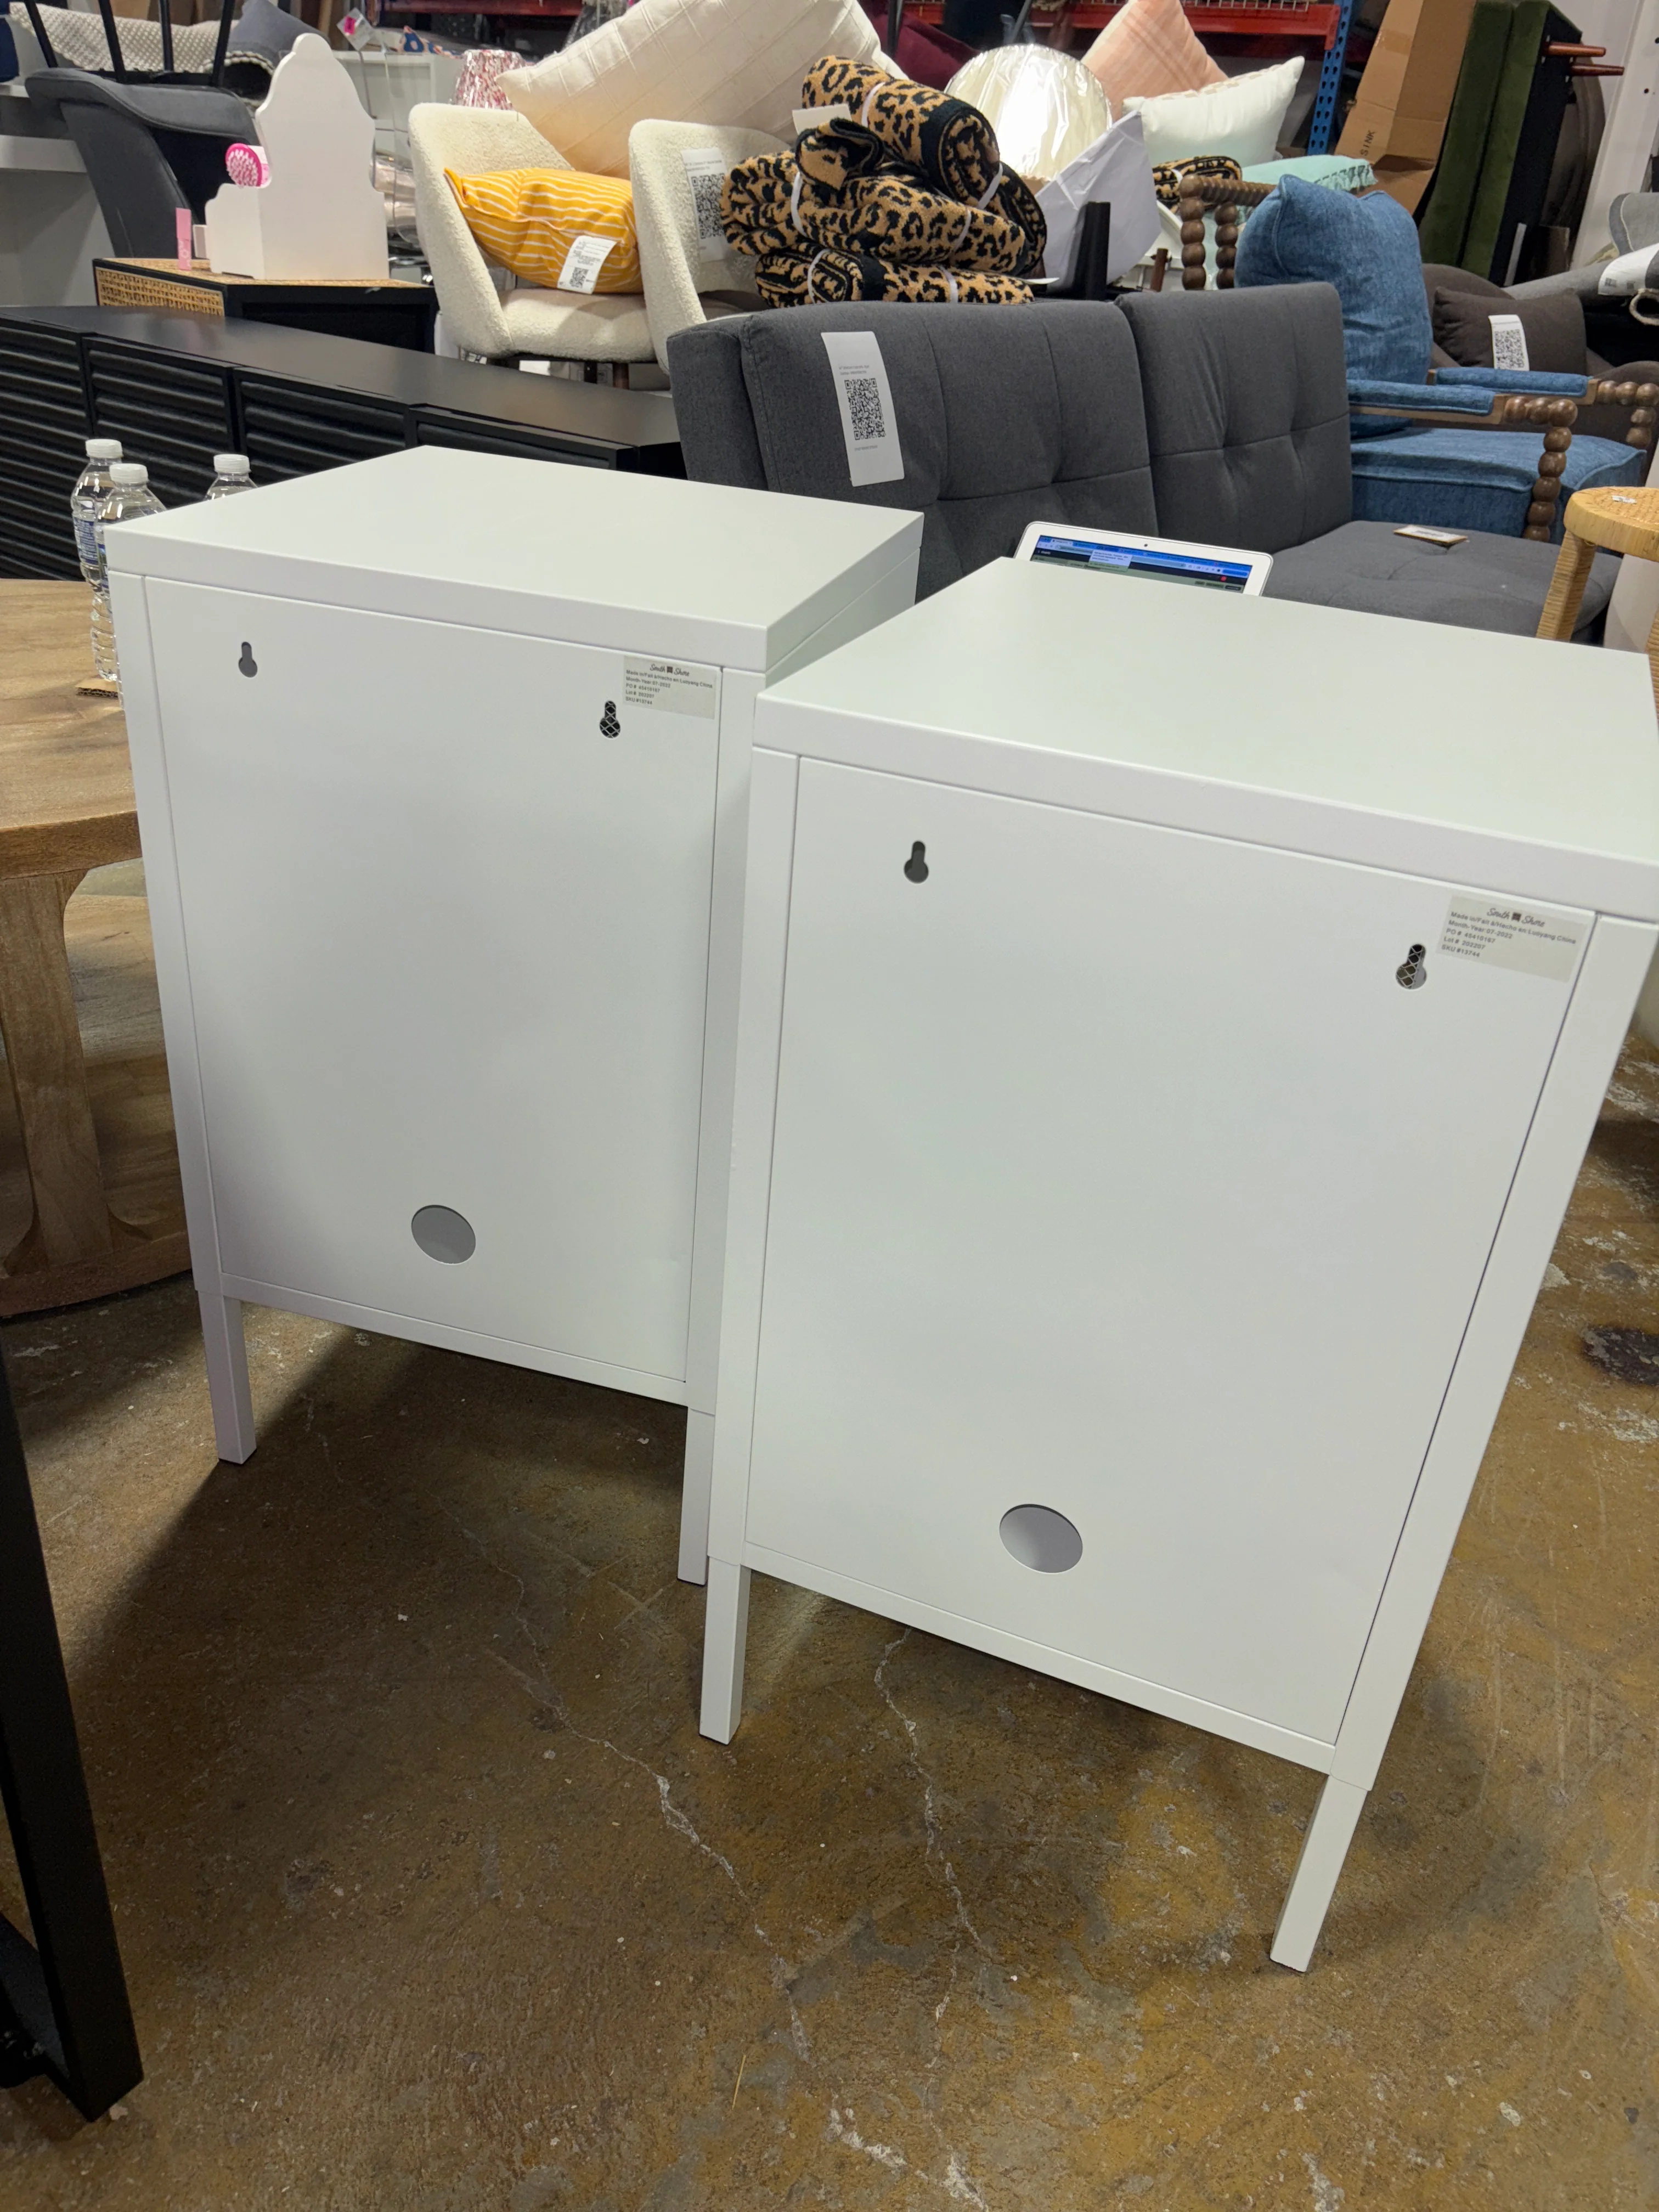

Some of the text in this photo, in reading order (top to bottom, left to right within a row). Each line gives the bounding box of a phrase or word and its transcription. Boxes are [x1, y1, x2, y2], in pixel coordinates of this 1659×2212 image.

[1487, 907, 1545, 927] South Shore
[1451, 911, 1468, 920] Made
[1557, 935, 1576, 944] China
[1441, 944, 1456, 952] SKU
[1462, 940, 1486, 950] 202207
